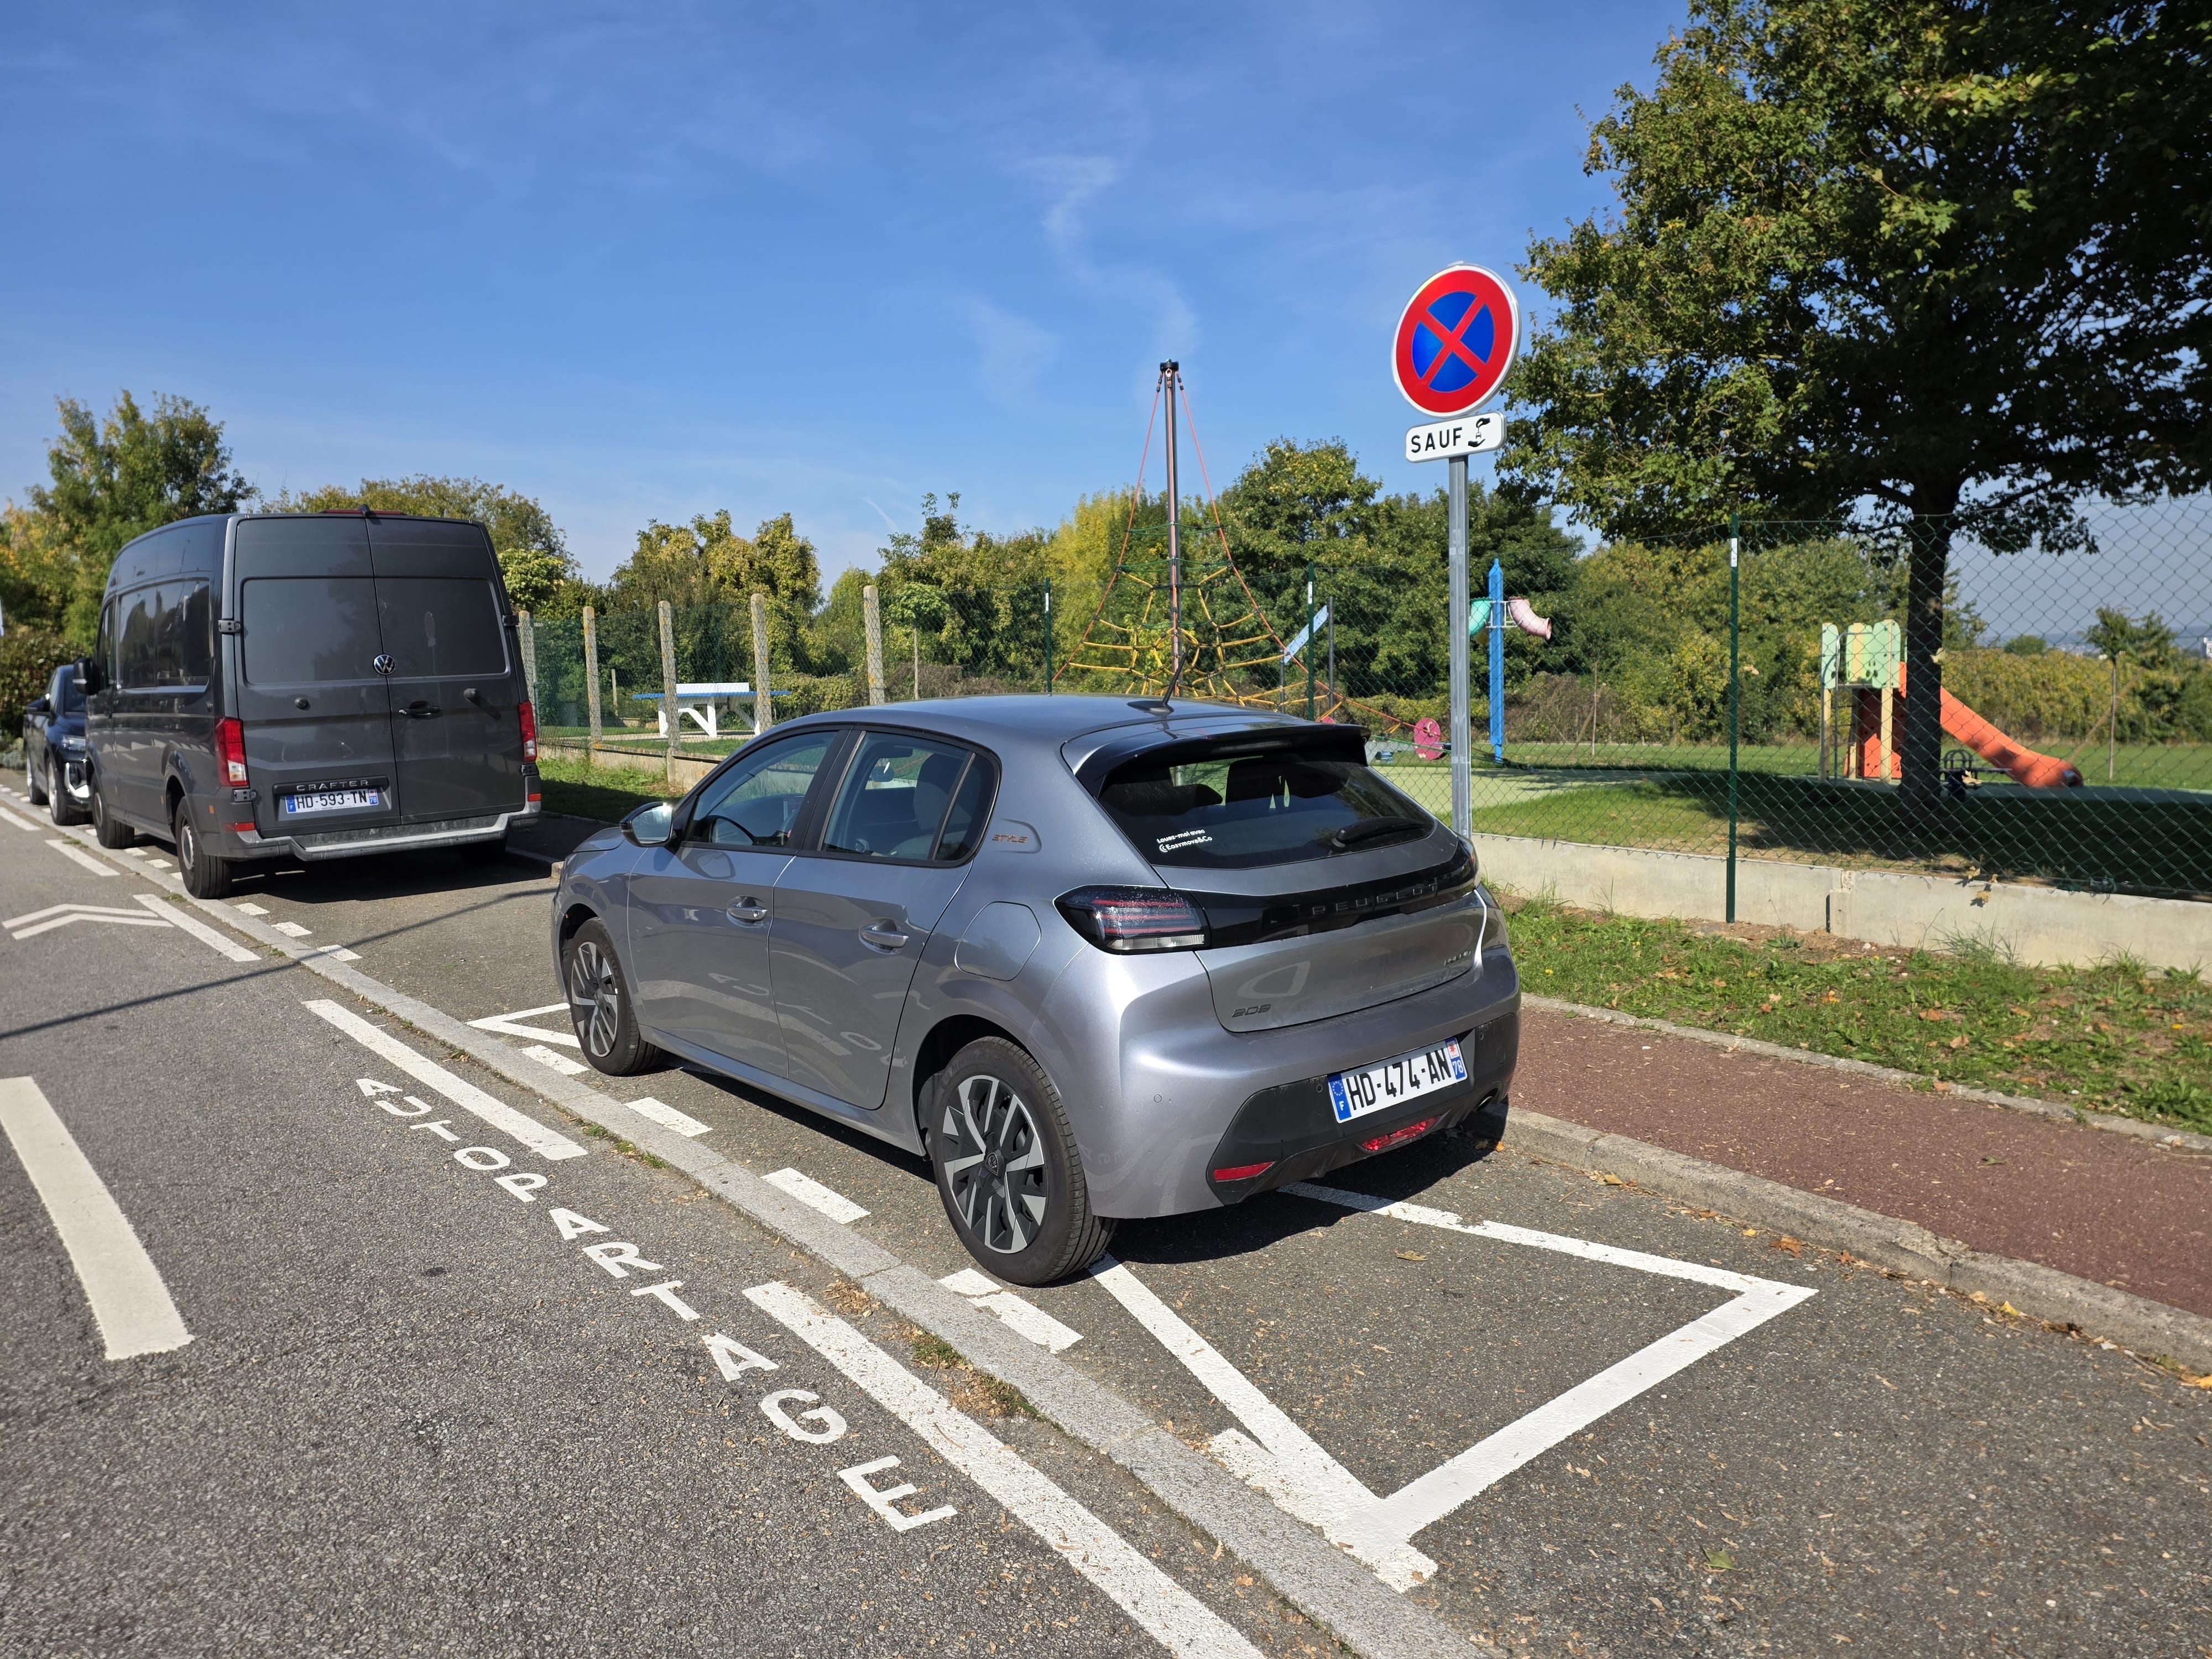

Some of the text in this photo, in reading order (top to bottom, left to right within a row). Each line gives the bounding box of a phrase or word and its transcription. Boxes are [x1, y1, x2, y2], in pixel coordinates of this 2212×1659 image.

[1411, 427, 1463, 453] SAUF
[296, 779, 369, 791] CRAFTER
[296, 790, 368, 809] HD-593-TN
[992, 834, 1028, 843] STYLE
[1156, 831, 1191, 843] Louez-moi
[1312, 881, 1438, 916] PEUGEOT
[1232, 1004, 1271, 1018] 208
[1339, 1047, 1464, 1111] F HD-474-AN 78
[356, 1078, 958, 1532] AUTOPARTAGE
